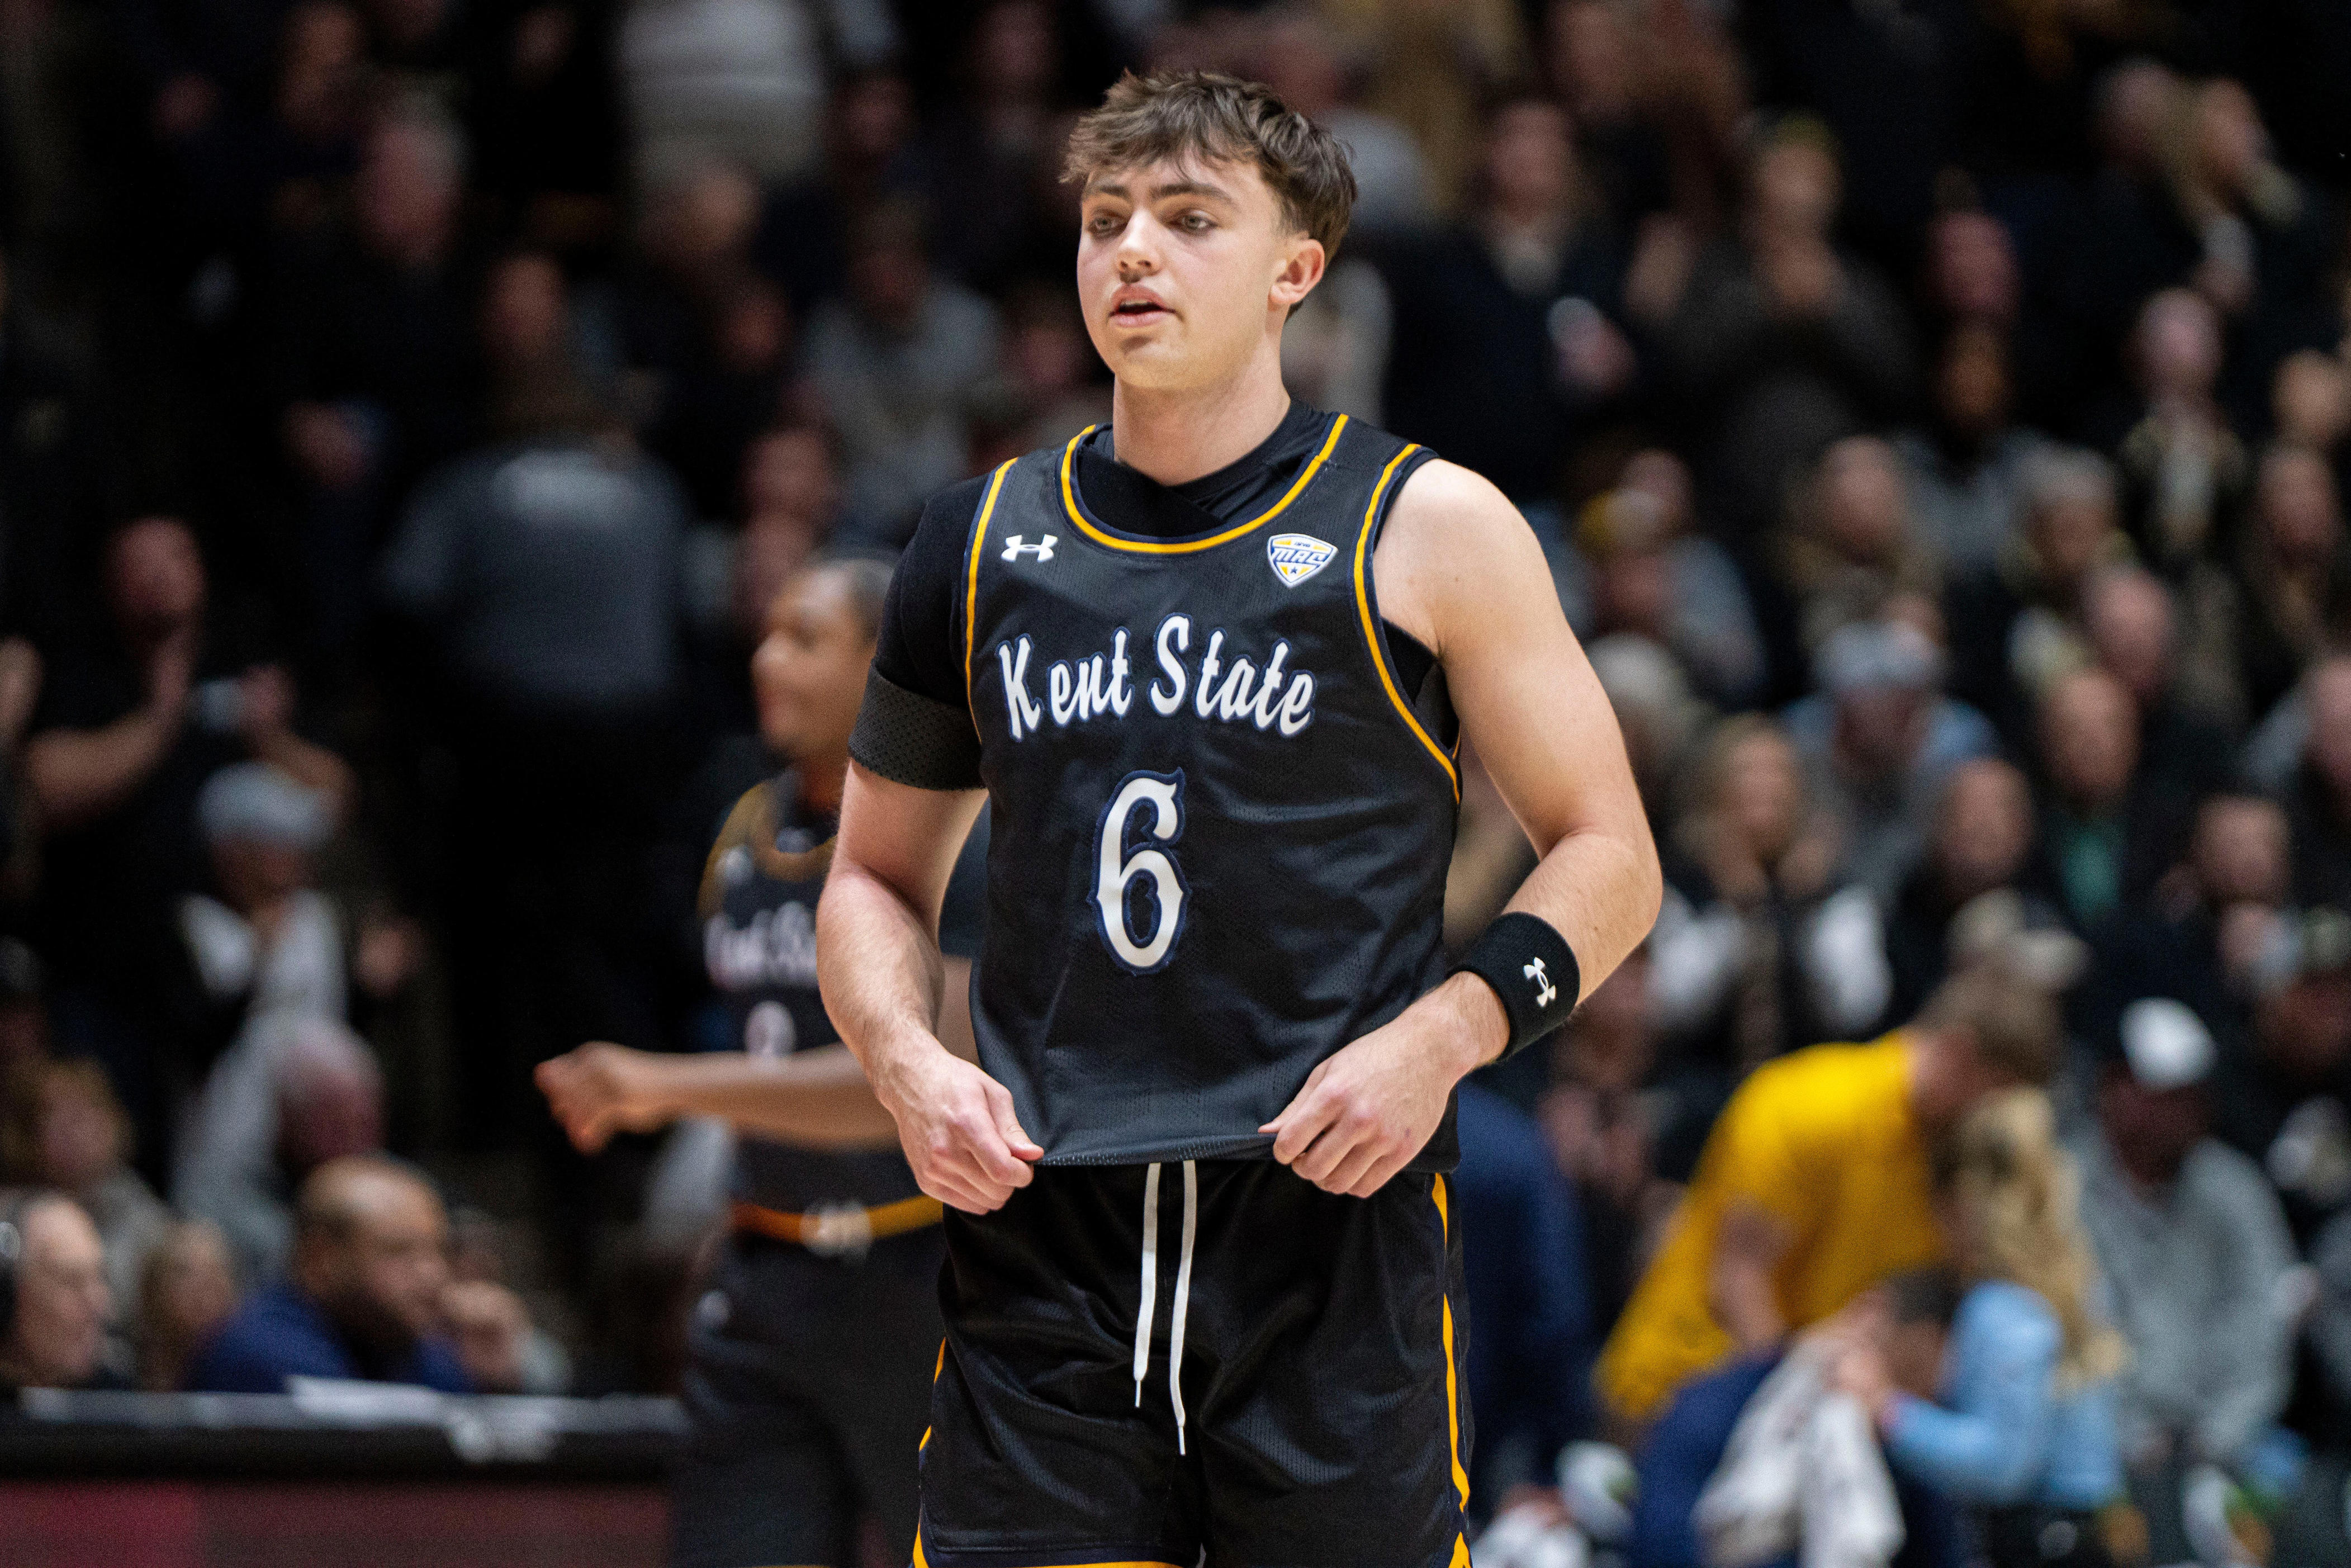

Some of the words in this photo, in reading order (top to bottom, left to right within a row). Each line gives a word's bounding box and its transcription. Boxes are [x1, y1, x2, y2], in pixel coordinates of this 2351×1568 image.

[1272, 547, 1328, 565] MAC
[997, 628, 1132, 740] Kent
[1150, 614, 1314, 736] State
[1095, 775, 1184, 968] 6
